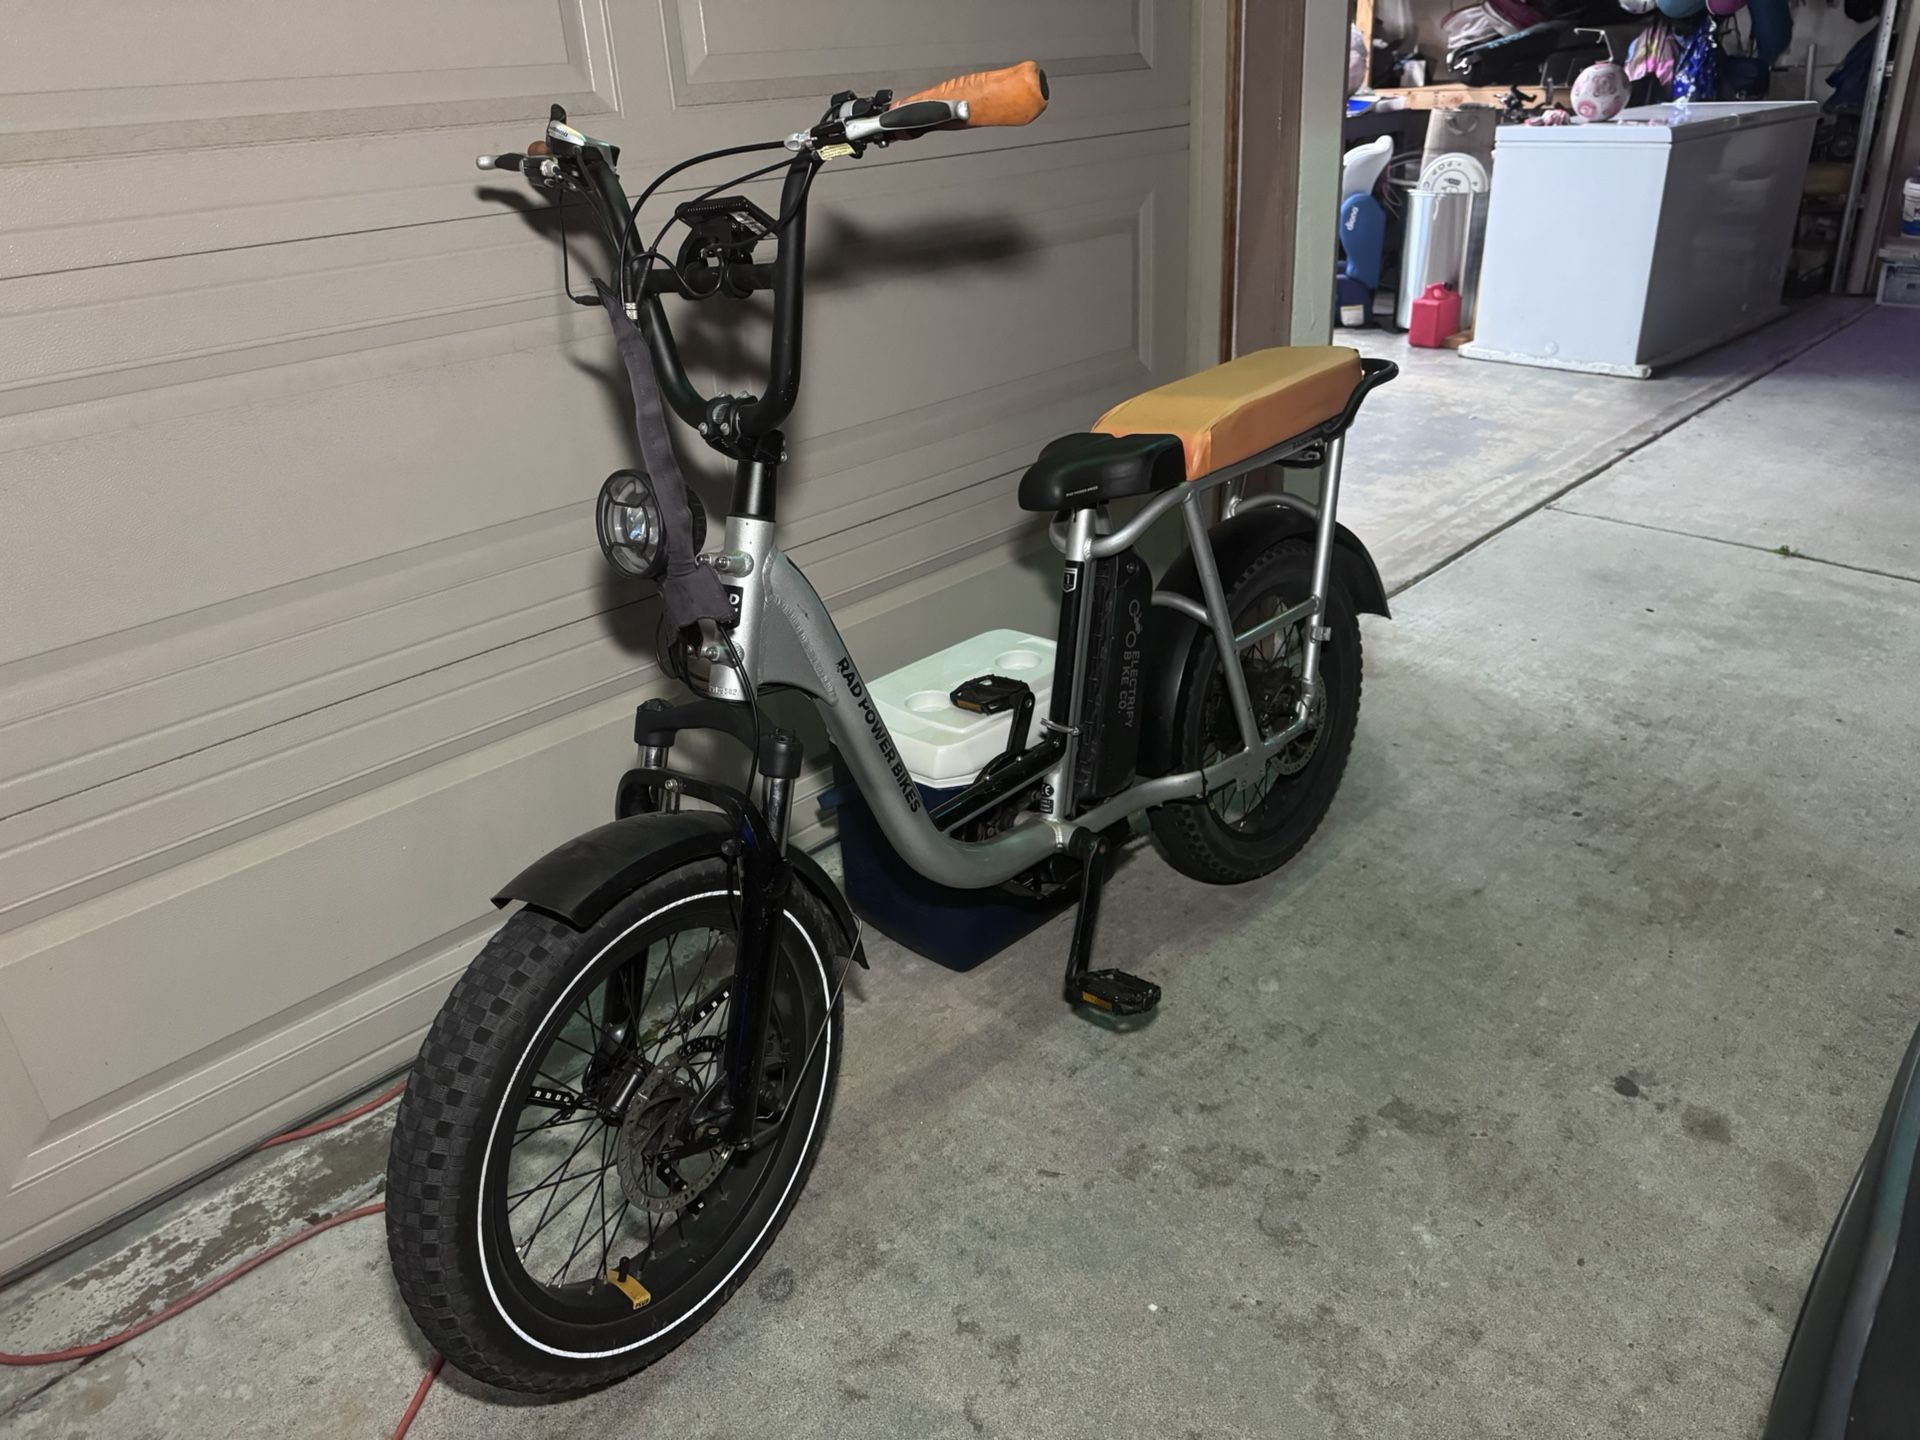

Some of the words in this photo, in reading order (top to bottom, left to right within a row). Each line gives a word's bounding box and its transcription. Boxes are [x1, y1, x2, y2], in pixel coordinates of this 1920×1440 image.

[1121, 651, 1131, 686] BKE
[1125, 651, 1140, 727] ELECTRIFY
[837, 657, 862, 697] RAD
[891, 763, 921, 812] BIKES
